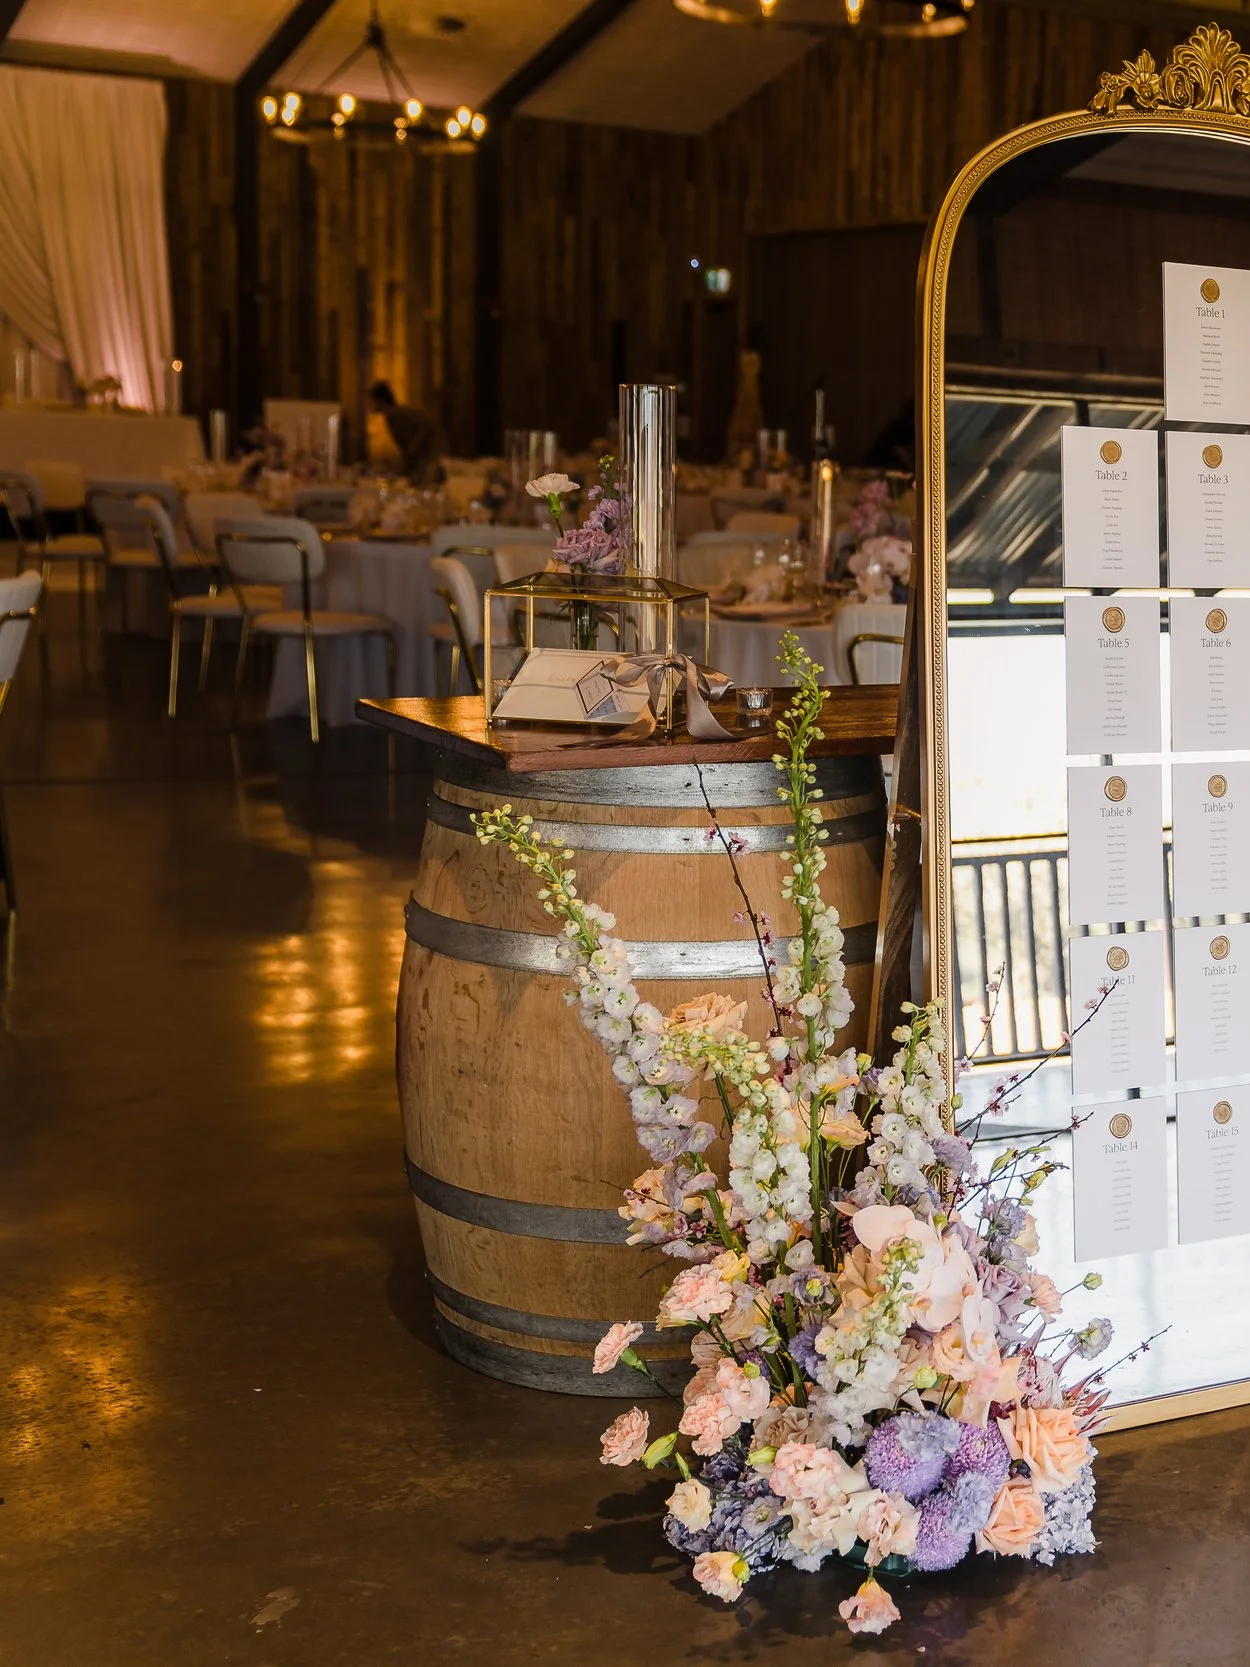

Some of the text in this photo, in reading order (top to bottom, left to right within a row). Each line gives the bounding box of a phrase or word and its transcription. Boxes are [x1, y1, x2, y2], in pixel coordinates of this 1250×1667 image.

[1196, 307, 1225, 318] Table 1
[1095, 470, 1128, 480] Table 2
[1198, 474, 1229, 484] Table 3
[1098, 638, 1130, 648] Table 5
[1201, 638, 1232, 647] Table 6
[1100, 807, 1133, 817] Table 8
[1203, 802, 1234, 812] Table 9
[1203, 965, 1236, 976] Table 12
[1128, 975, 1135, 984] 11
[1206, 1126, 1239, 1139] Table 15
[1103, 1141, 1138, 1153] Table 14
